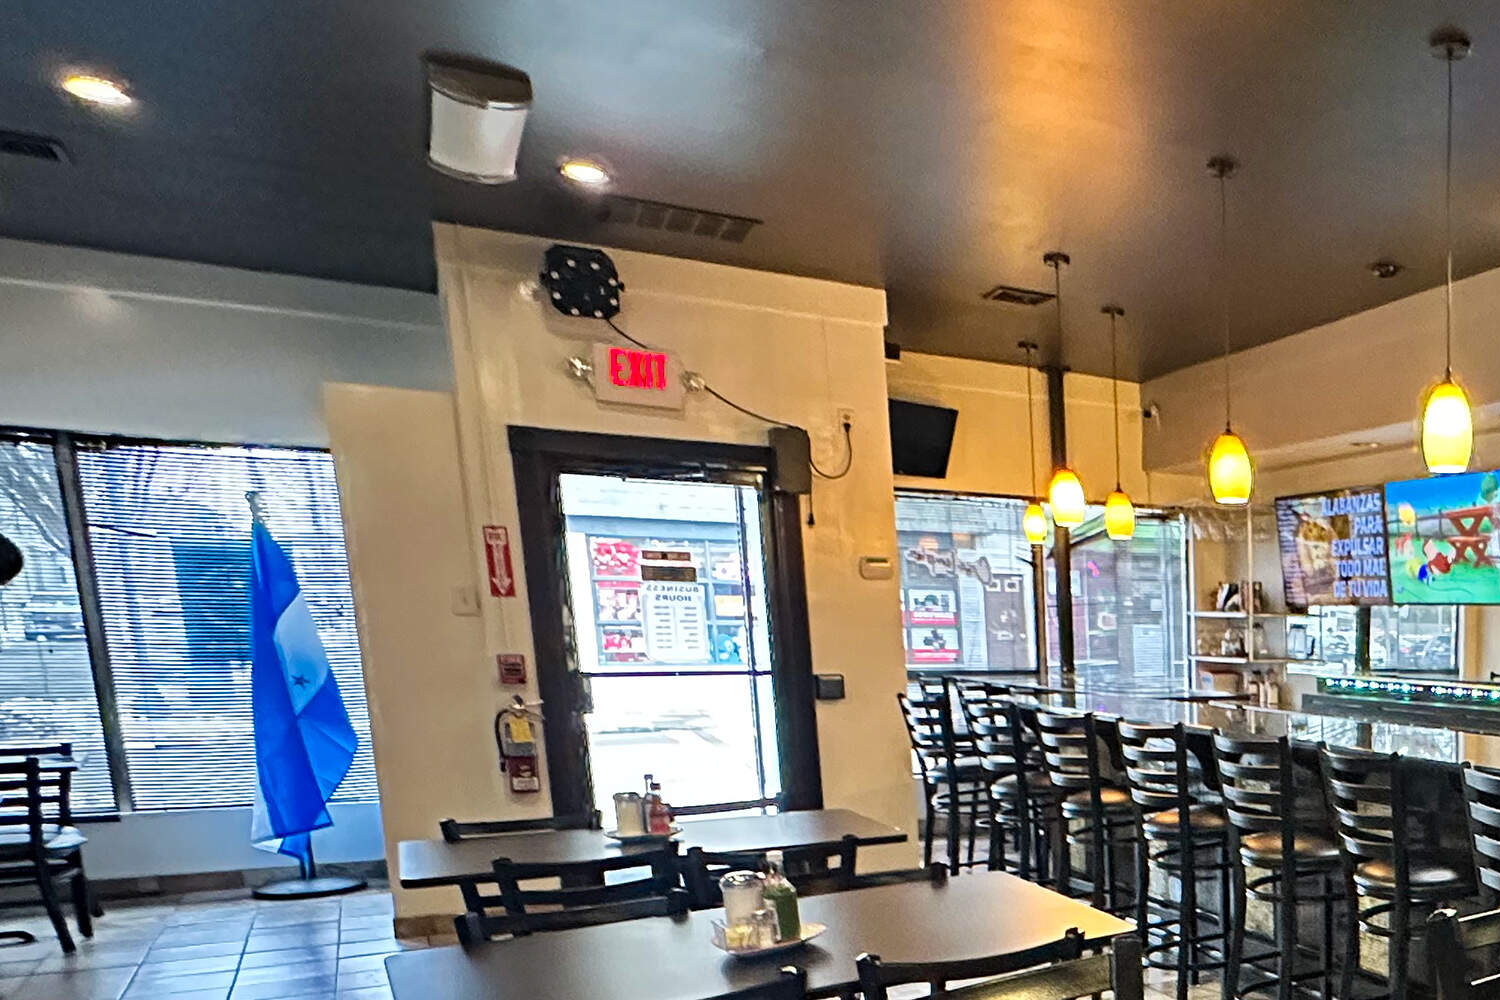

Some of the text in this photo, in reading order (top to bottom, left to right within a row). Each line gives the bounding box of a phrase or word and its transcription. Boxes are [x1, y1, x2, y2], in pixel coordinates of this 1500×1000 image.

[608, 348, 667, 390] EXIT
[1321, 493, 1381, 515] ALABANZAS
[1353, 515, 1384, 534] PARA
[1331, 537, 1385, 557] EXPULSAR
[1335, 559, 1362, 577] TODO
[1333, 579, 1388, 598] DE TU VIDA
